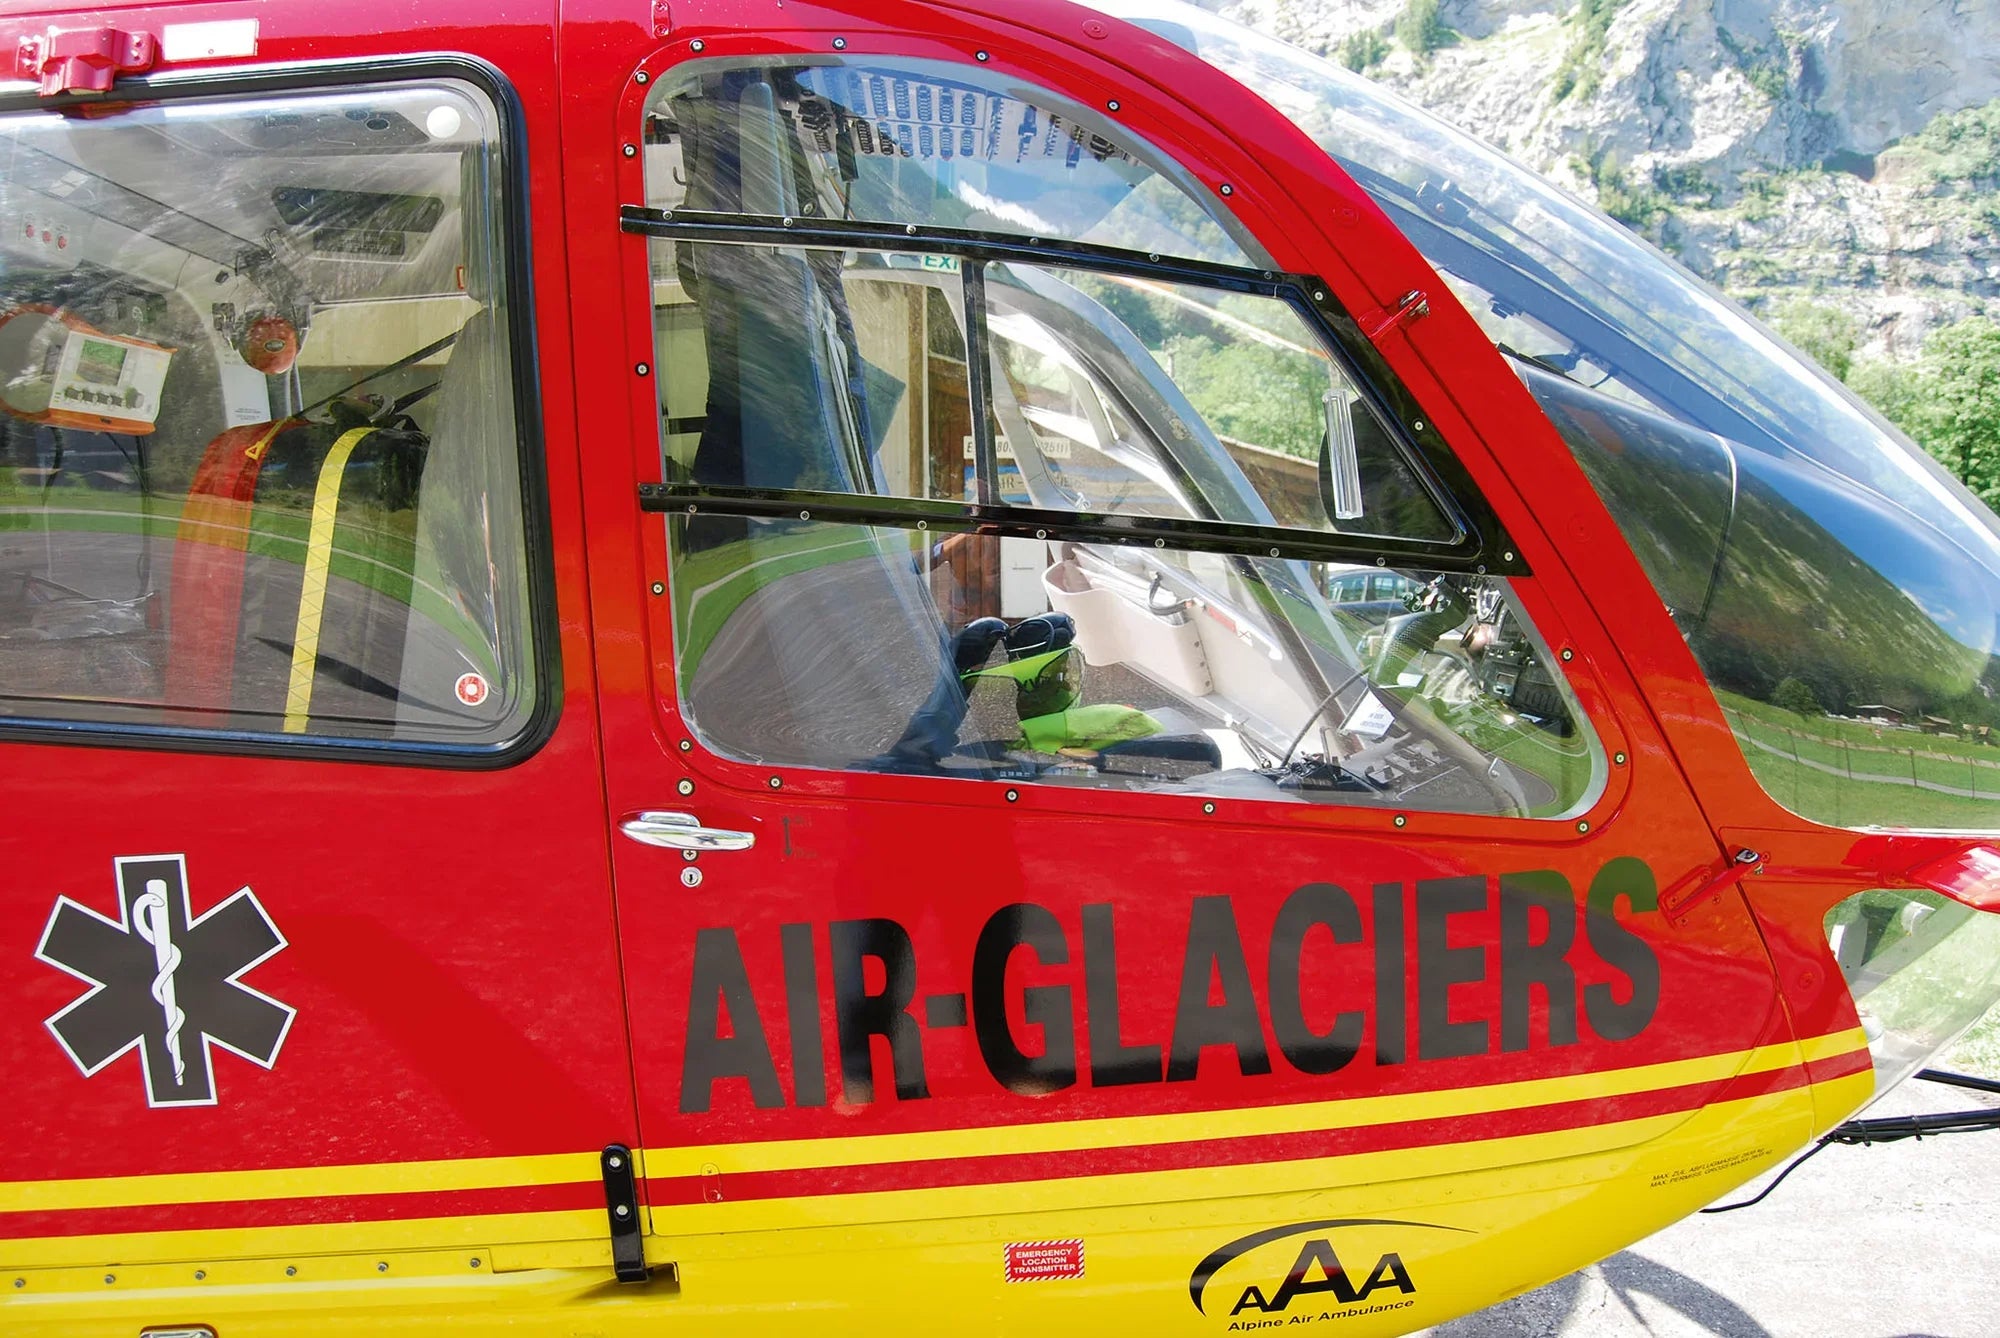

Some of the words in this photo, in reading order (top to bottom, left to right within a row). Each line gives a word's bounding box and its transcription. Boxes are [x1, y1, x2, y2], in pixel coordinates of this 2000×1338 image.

[925, 254, 958, 270] EXI
[678, 857, 1660, 1112] AIR-GLACIERS
[1016, 1248, 1072, 1258] EMERGENCY
[1014, 1263, 1076, 1273] TRANSMITTER
[1022, 1257, 1067, 1266] LOCATION
[1229, 1239, 1416, 1316] AAA
[1228, 1317, 1283, 1331] Alpine
[1289, 1315, 1313, 1325] Air
[1318, 1300, 1414, 1321] Ambulance
